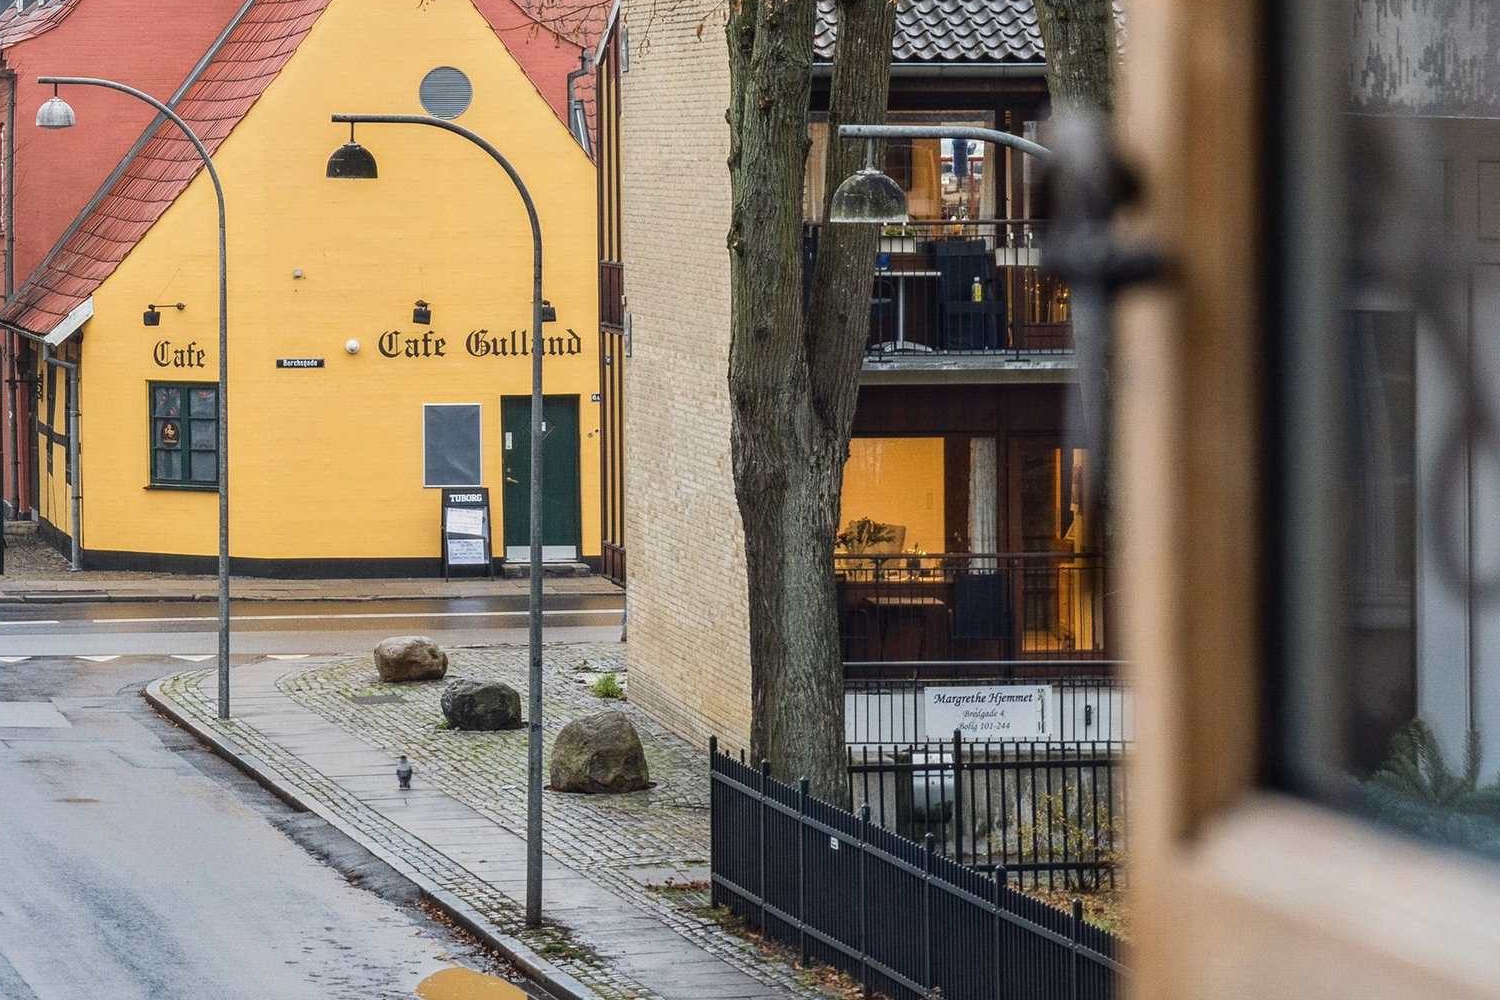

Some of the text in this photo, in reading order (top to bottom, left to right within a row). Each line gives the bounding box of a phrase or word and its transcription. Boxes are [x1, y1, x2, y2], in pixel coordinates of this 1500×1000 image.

[378, 330, 447, 358] Cafe
[153, 340, 206, 368] Cafe
[449, 494, 483, 502] TUBORG
[934, 691, 1033, 706] Margrethe Hjemmet
[963, 709, 1005, 719] Bredgade 4
[959, 722, 1011, 732] Bolig 101-244
